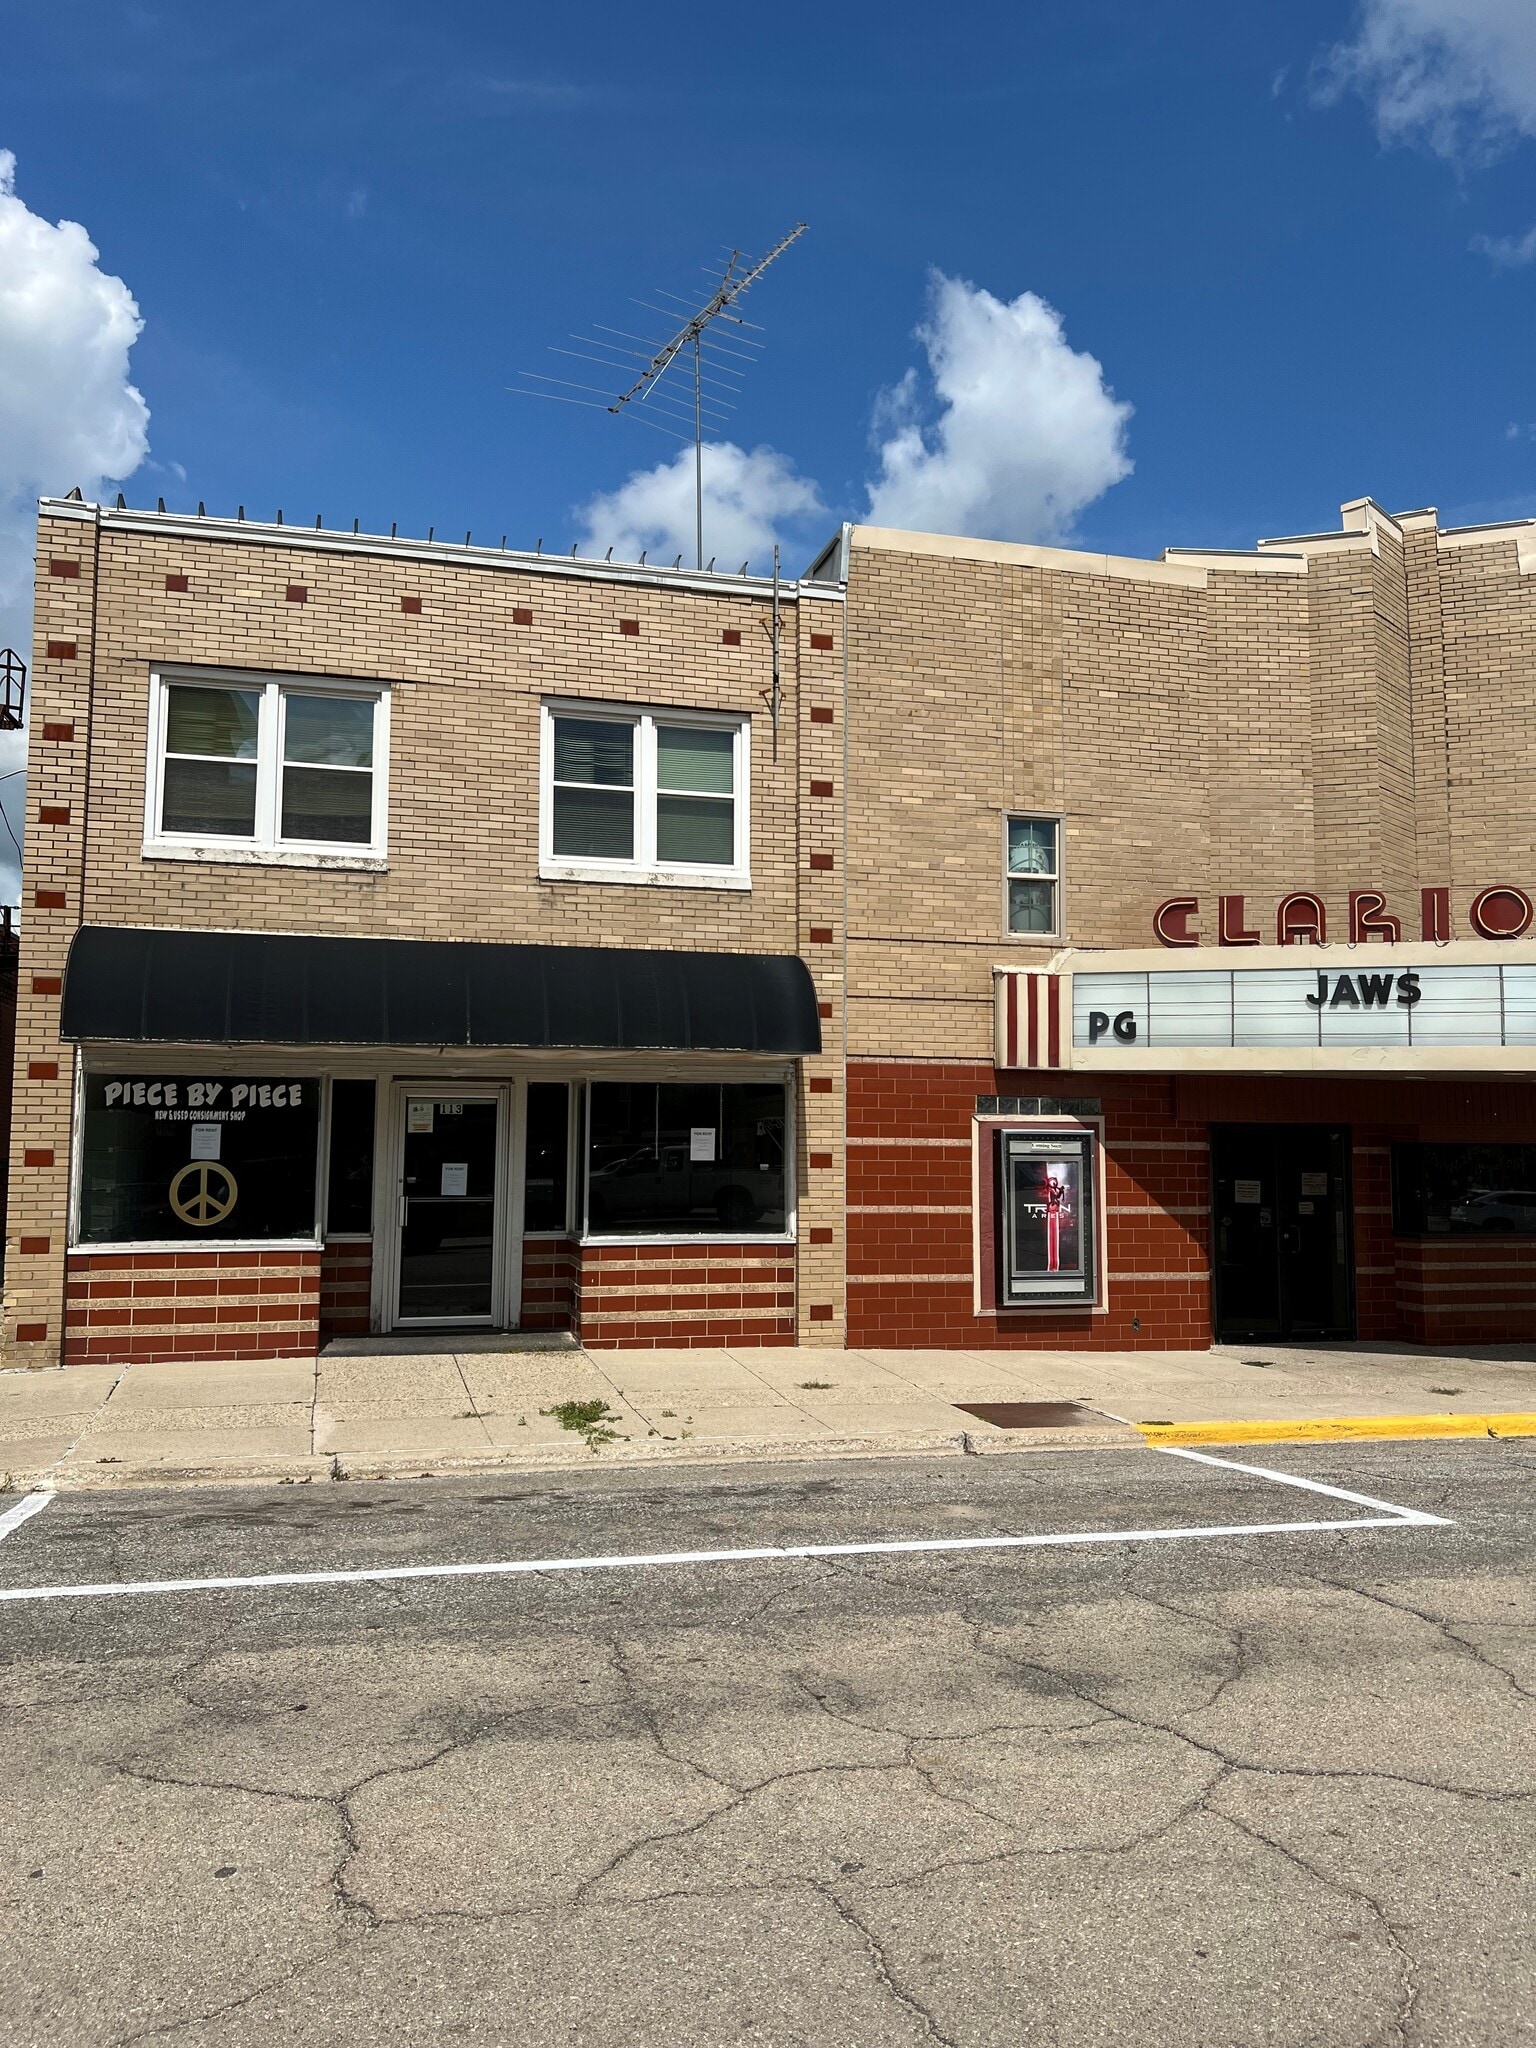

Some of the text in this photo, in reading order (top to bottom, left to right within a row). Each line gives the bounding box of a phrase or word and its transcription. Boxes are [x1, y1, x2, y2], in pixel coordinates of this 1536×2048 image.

[1153, 885, 1533, 948] CLARIO
[1306, 973, 1422, 1006] JAWS
[1089, 1011, 1137, 1042] PG
[104, 1082, 302, 1108] PIECE BY PIECE
[154, 1110, 168, 1120] NEW
[173, 1110, 188, 1120] USED
[189, 1110, 229, 1120] CONSIGNMENT
[230, 1110, 246, 1121] SHOP
[441, 1104, 462, 1114] 113
[1024, 1204, 1070, 1213] TRON
